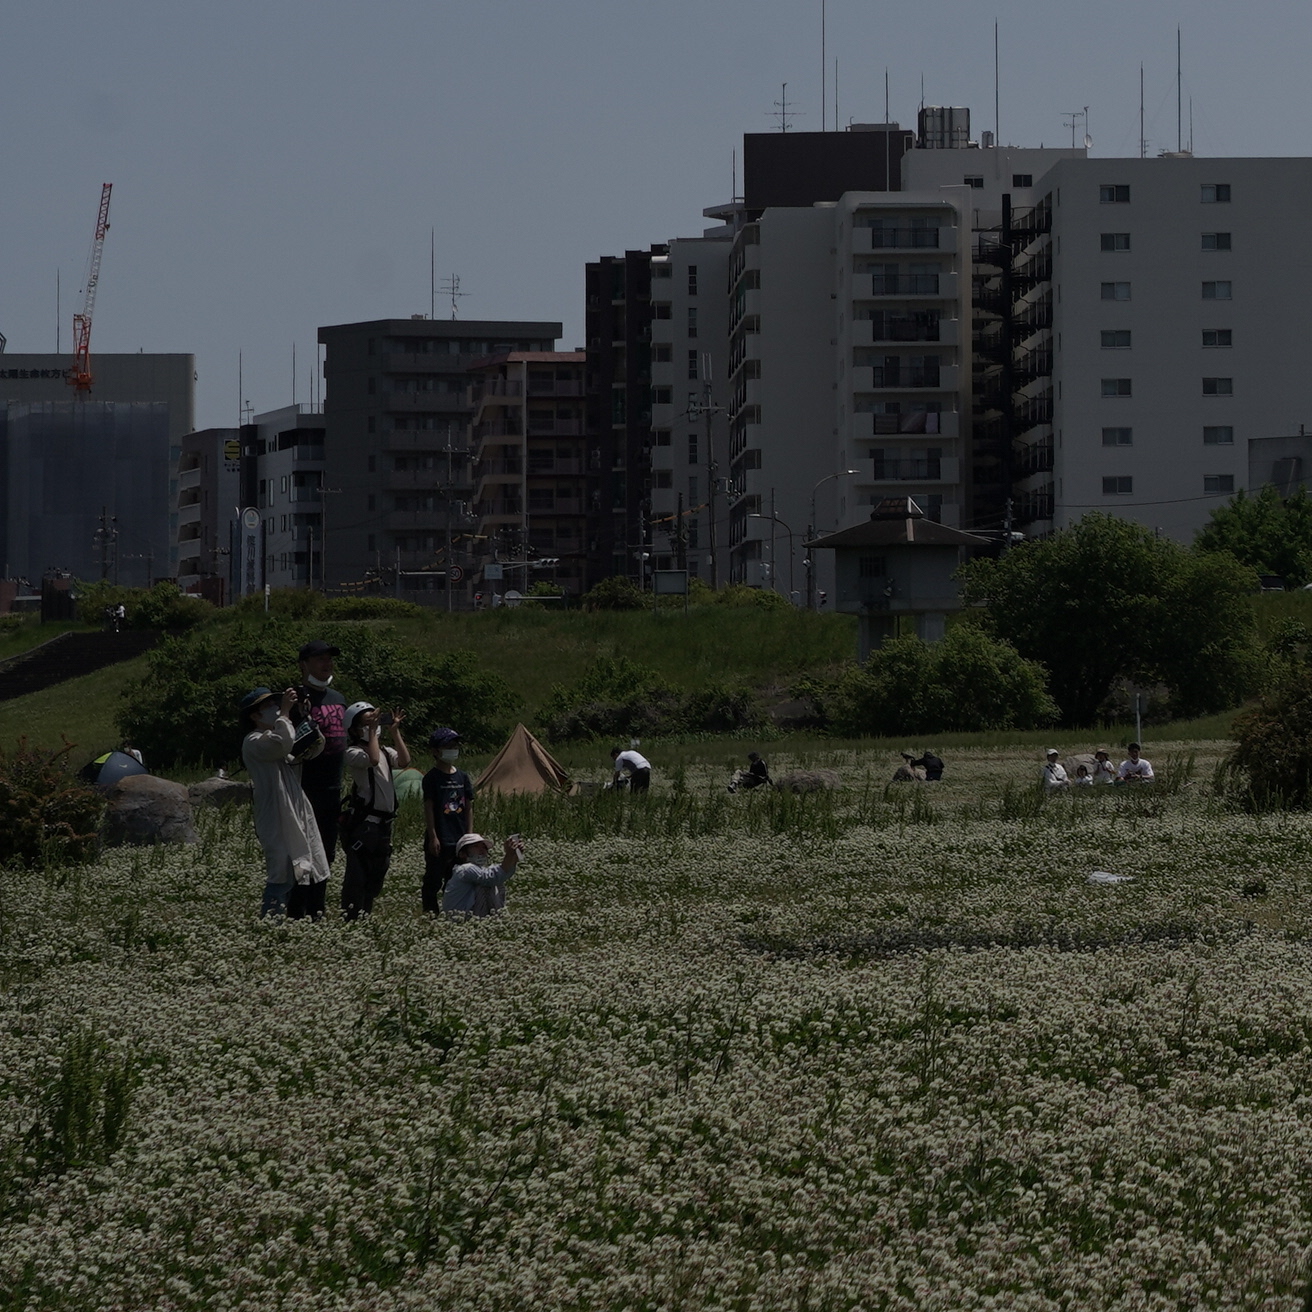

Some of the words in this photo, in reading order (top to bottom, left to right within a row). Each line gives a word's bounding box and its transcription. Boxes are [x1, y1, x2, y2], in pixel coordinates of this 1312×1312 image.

[0, 368, 73, 379] 太陽生命枚方ビ
